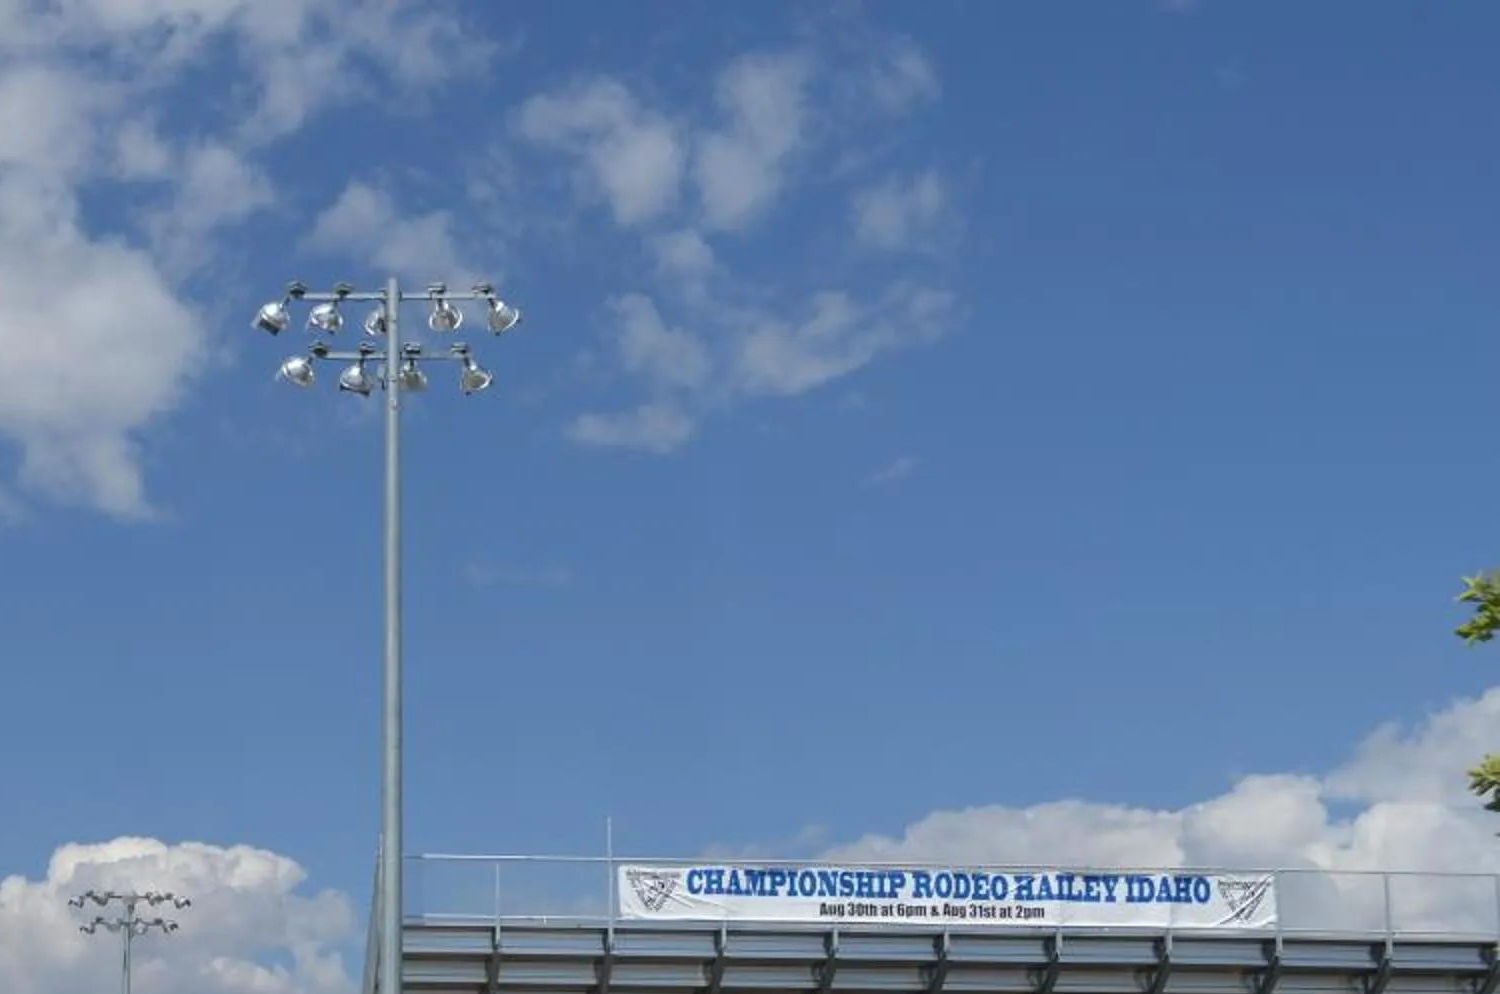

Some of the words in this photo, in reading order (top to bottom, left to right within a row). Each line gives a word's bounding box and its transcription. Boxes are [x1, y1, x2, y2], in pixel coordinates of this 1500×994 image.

[686, 868, 906, 898] CHAMPIONSHIP
[912, 870, 1009, 900] RODEO
[1014, 873, 1118, 903] HAILEY
[1125, 874, 1212, 903] IDAHO
[819, 902, 845, 917] Aug
[846, 902, 878, 916] 30th
[880, 904, 895, 916] at
[896, 903, 927, 918] 6pm
[931, 904, 940, 916] &
[942, 903, 967, 919] Aug
[968, 904, 998, 919] 31st
[999, 905, 1013, 918] at
[1015, 905, 1045, 920] 2pm
